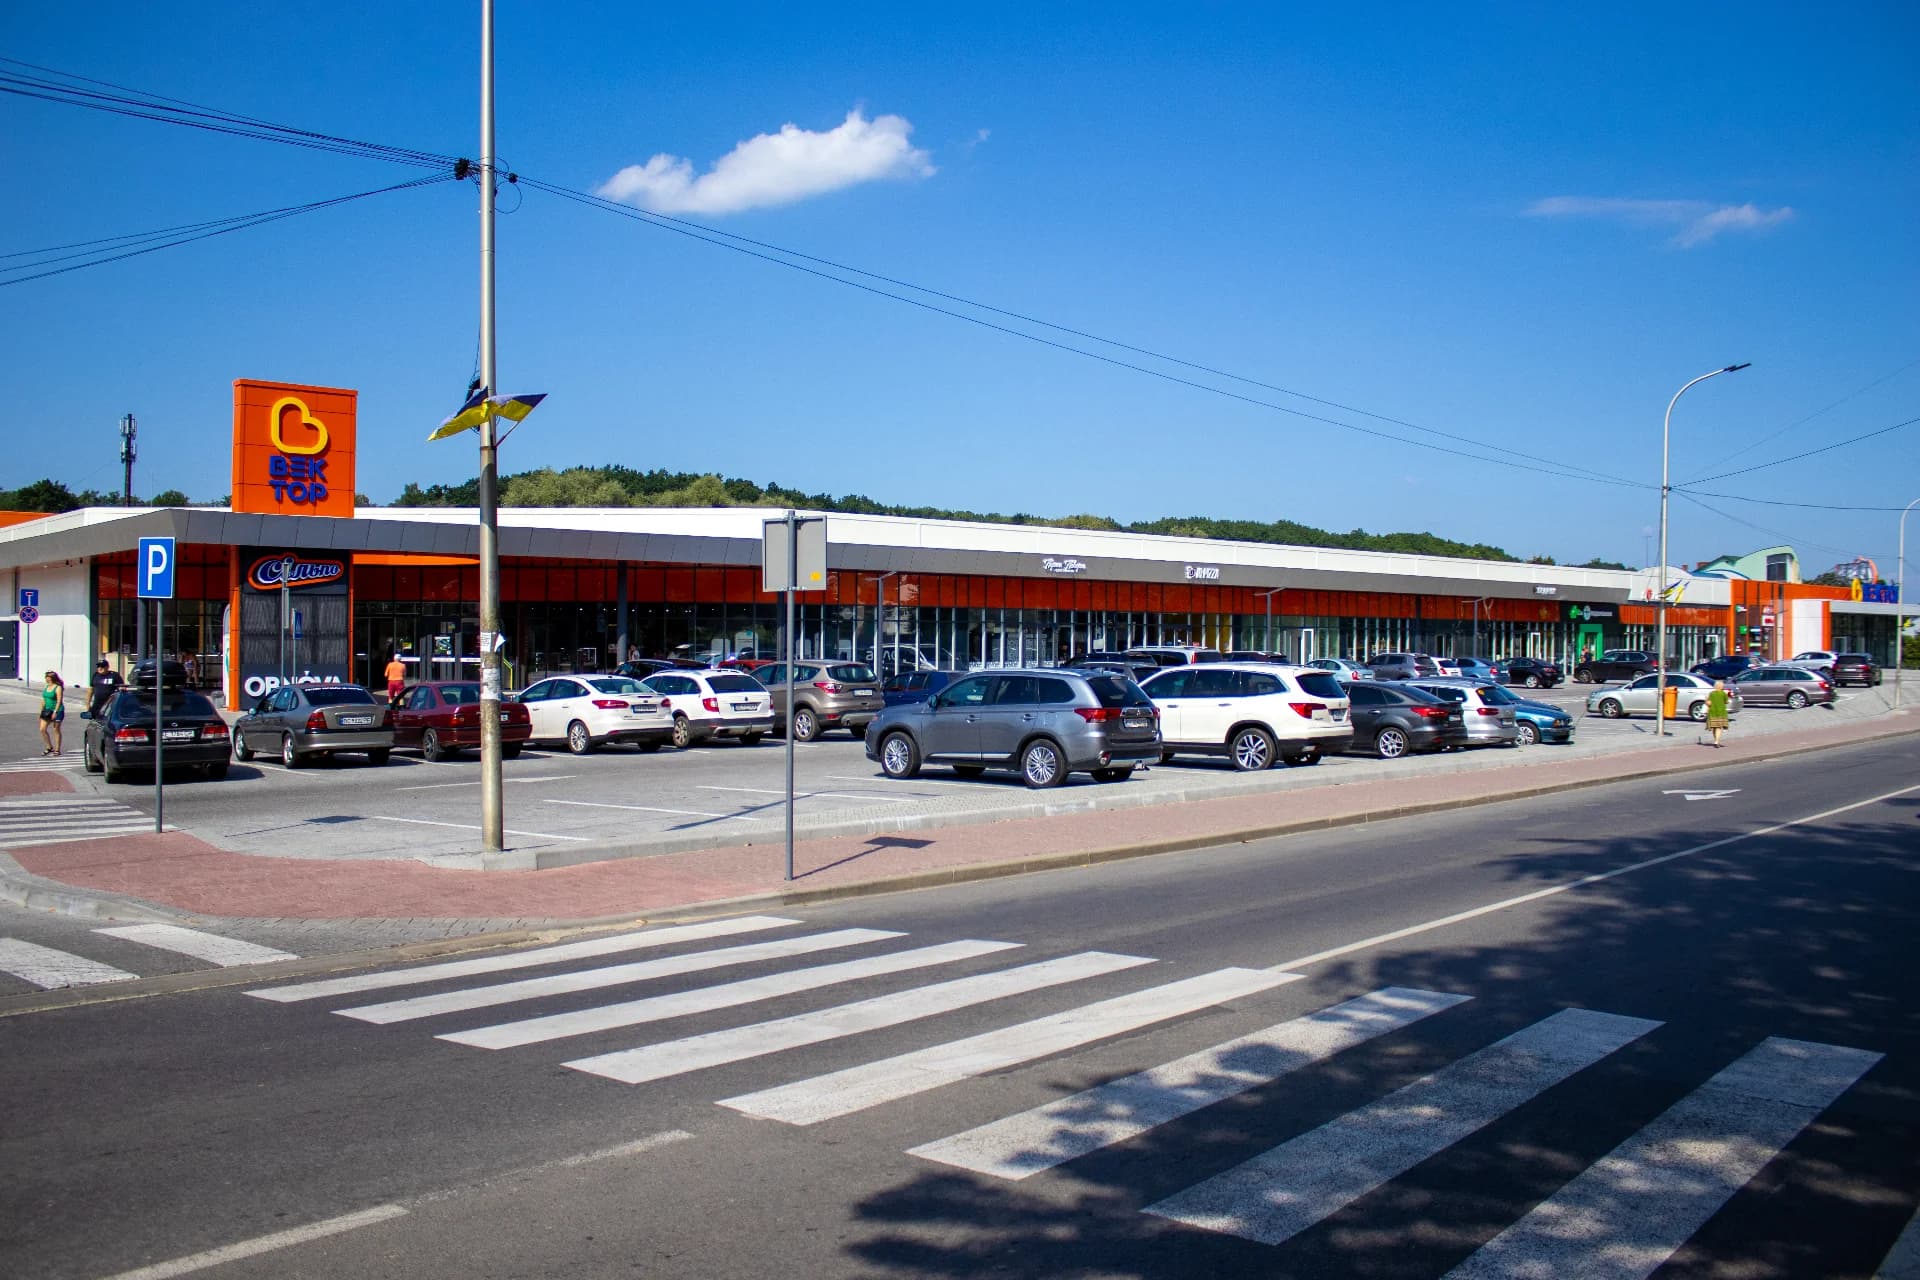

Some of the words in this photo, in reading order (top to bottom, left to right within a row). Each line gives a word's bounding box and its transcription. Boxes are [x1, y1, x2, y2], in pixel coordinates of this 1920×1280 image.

[268, 455, 327, 481] ВЕК
[268, 479, 328, 503] ТОР
[147, 544, 168, 591] P
